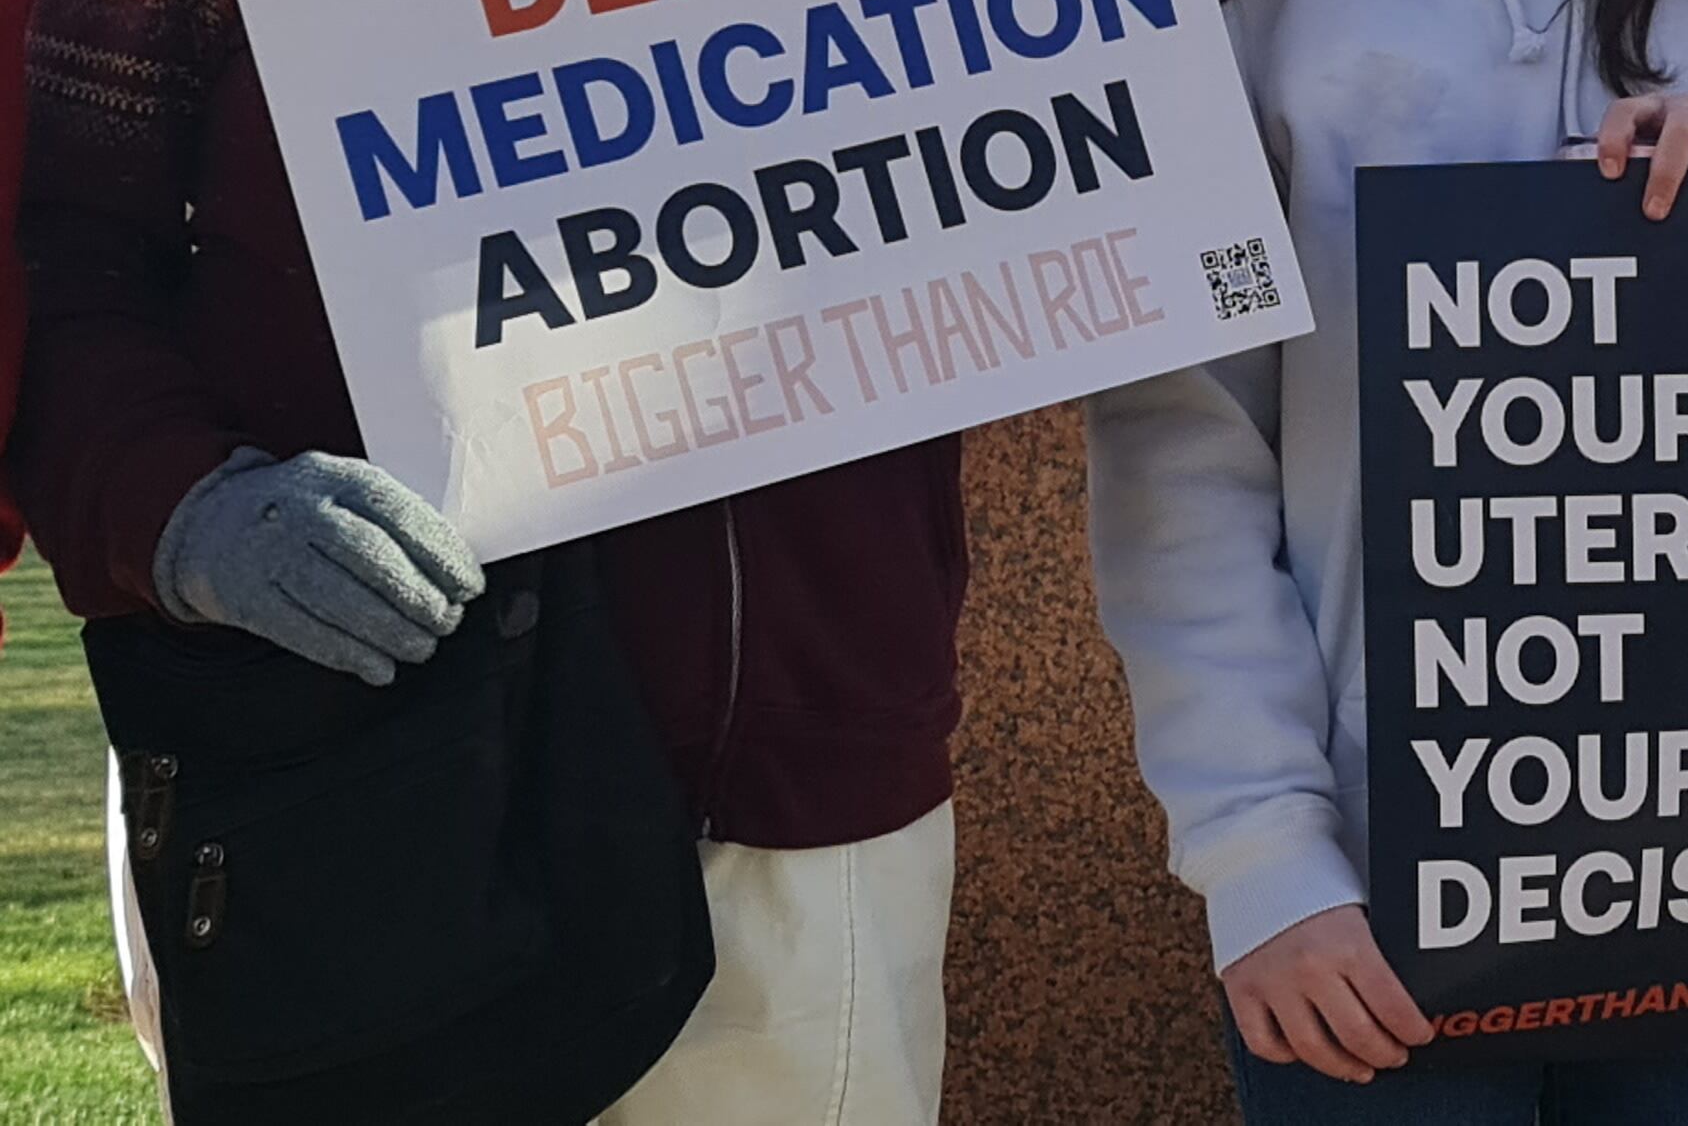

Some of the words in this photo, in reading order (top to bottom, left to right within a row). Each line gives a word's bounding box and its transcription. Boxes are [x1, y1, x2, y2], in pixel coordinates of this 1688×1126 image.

[474, 80, 1153, 349] ABORTION
[1406, 256, 1638, 349] NOT
[522, 314, 836, 490] BIGGER
[820, 262, 1036, 403] THAN
[1028, 228, 1166, 352] ROE
[1414, 613, 1645, 708] NOT
